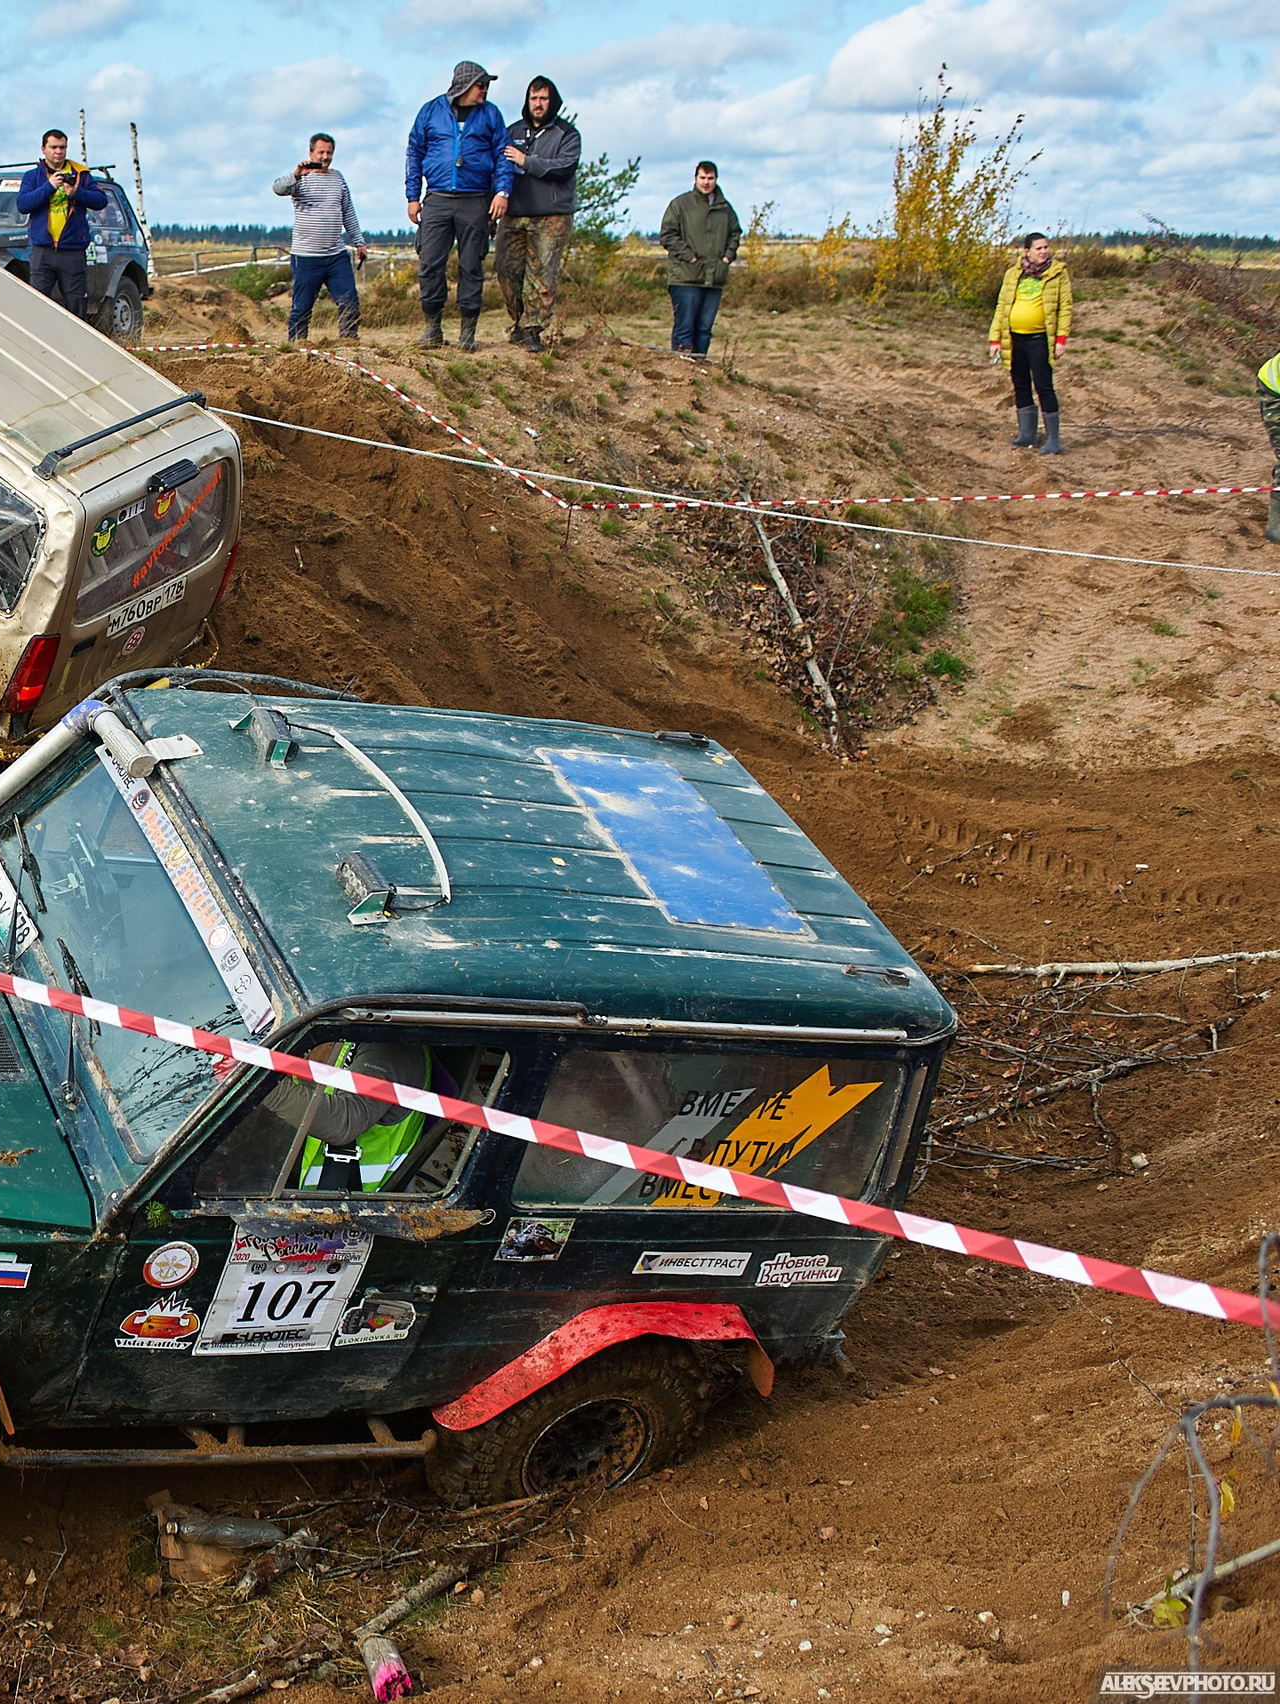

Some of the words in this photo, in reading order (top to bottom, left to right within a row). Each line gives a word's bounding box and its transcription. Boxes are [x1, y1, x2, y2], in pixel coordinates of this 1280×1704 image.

[164, 580, 184, 600] 178
[232, 1253, 250, 1261] 2020
[263, 1241, 318, 1261] России
[658, 1257, 747, 1269] ИНВЕСТТРАСТ
[763, 1252, 826, 1270] Новые
[759, 1267, 839, 1284] Ватутинки
[236, 1280, 336, 1323] 107
[234, 1328, 306, 1342] SUPROTEC
[338, 1332, 406, 1345] BLOKIROVKA.RU
